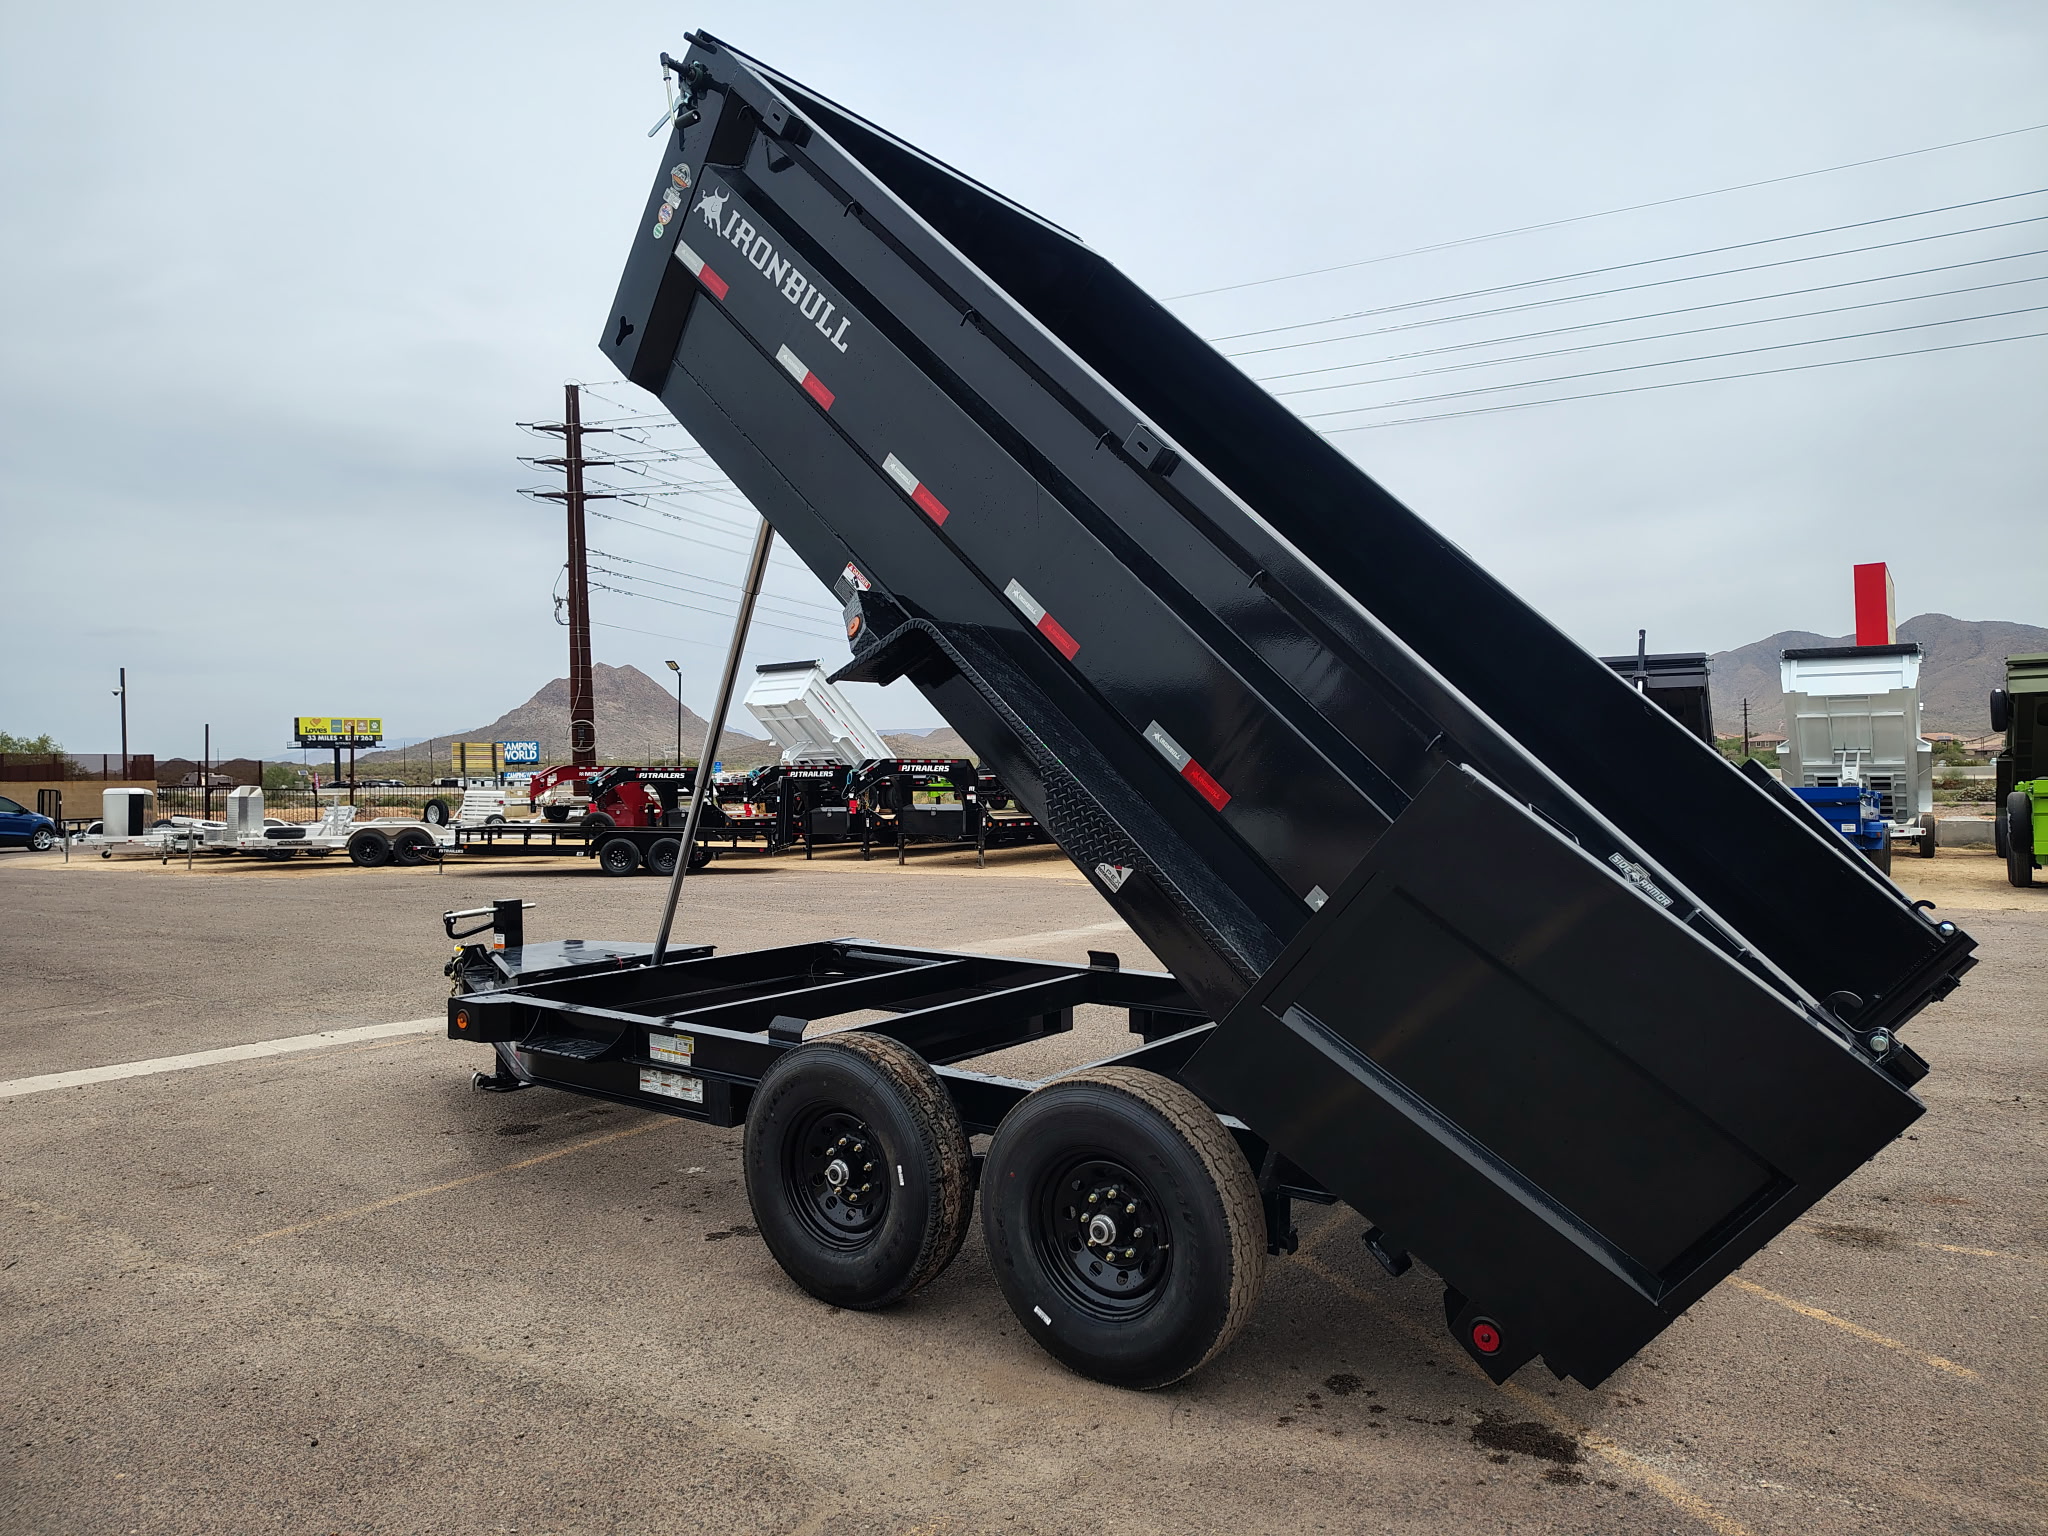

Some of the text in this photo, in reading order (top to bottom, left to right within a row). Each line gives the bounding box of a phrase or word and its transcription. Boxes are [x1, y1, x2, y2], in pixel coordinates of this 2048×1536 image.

[722, 209, 851, 354] IRONBULL
[911, 764, 950, 772] TRAILERS
[1611, 854, 1632, 874] SIDE
[1639, 879, 1671, 906] ARMOR
